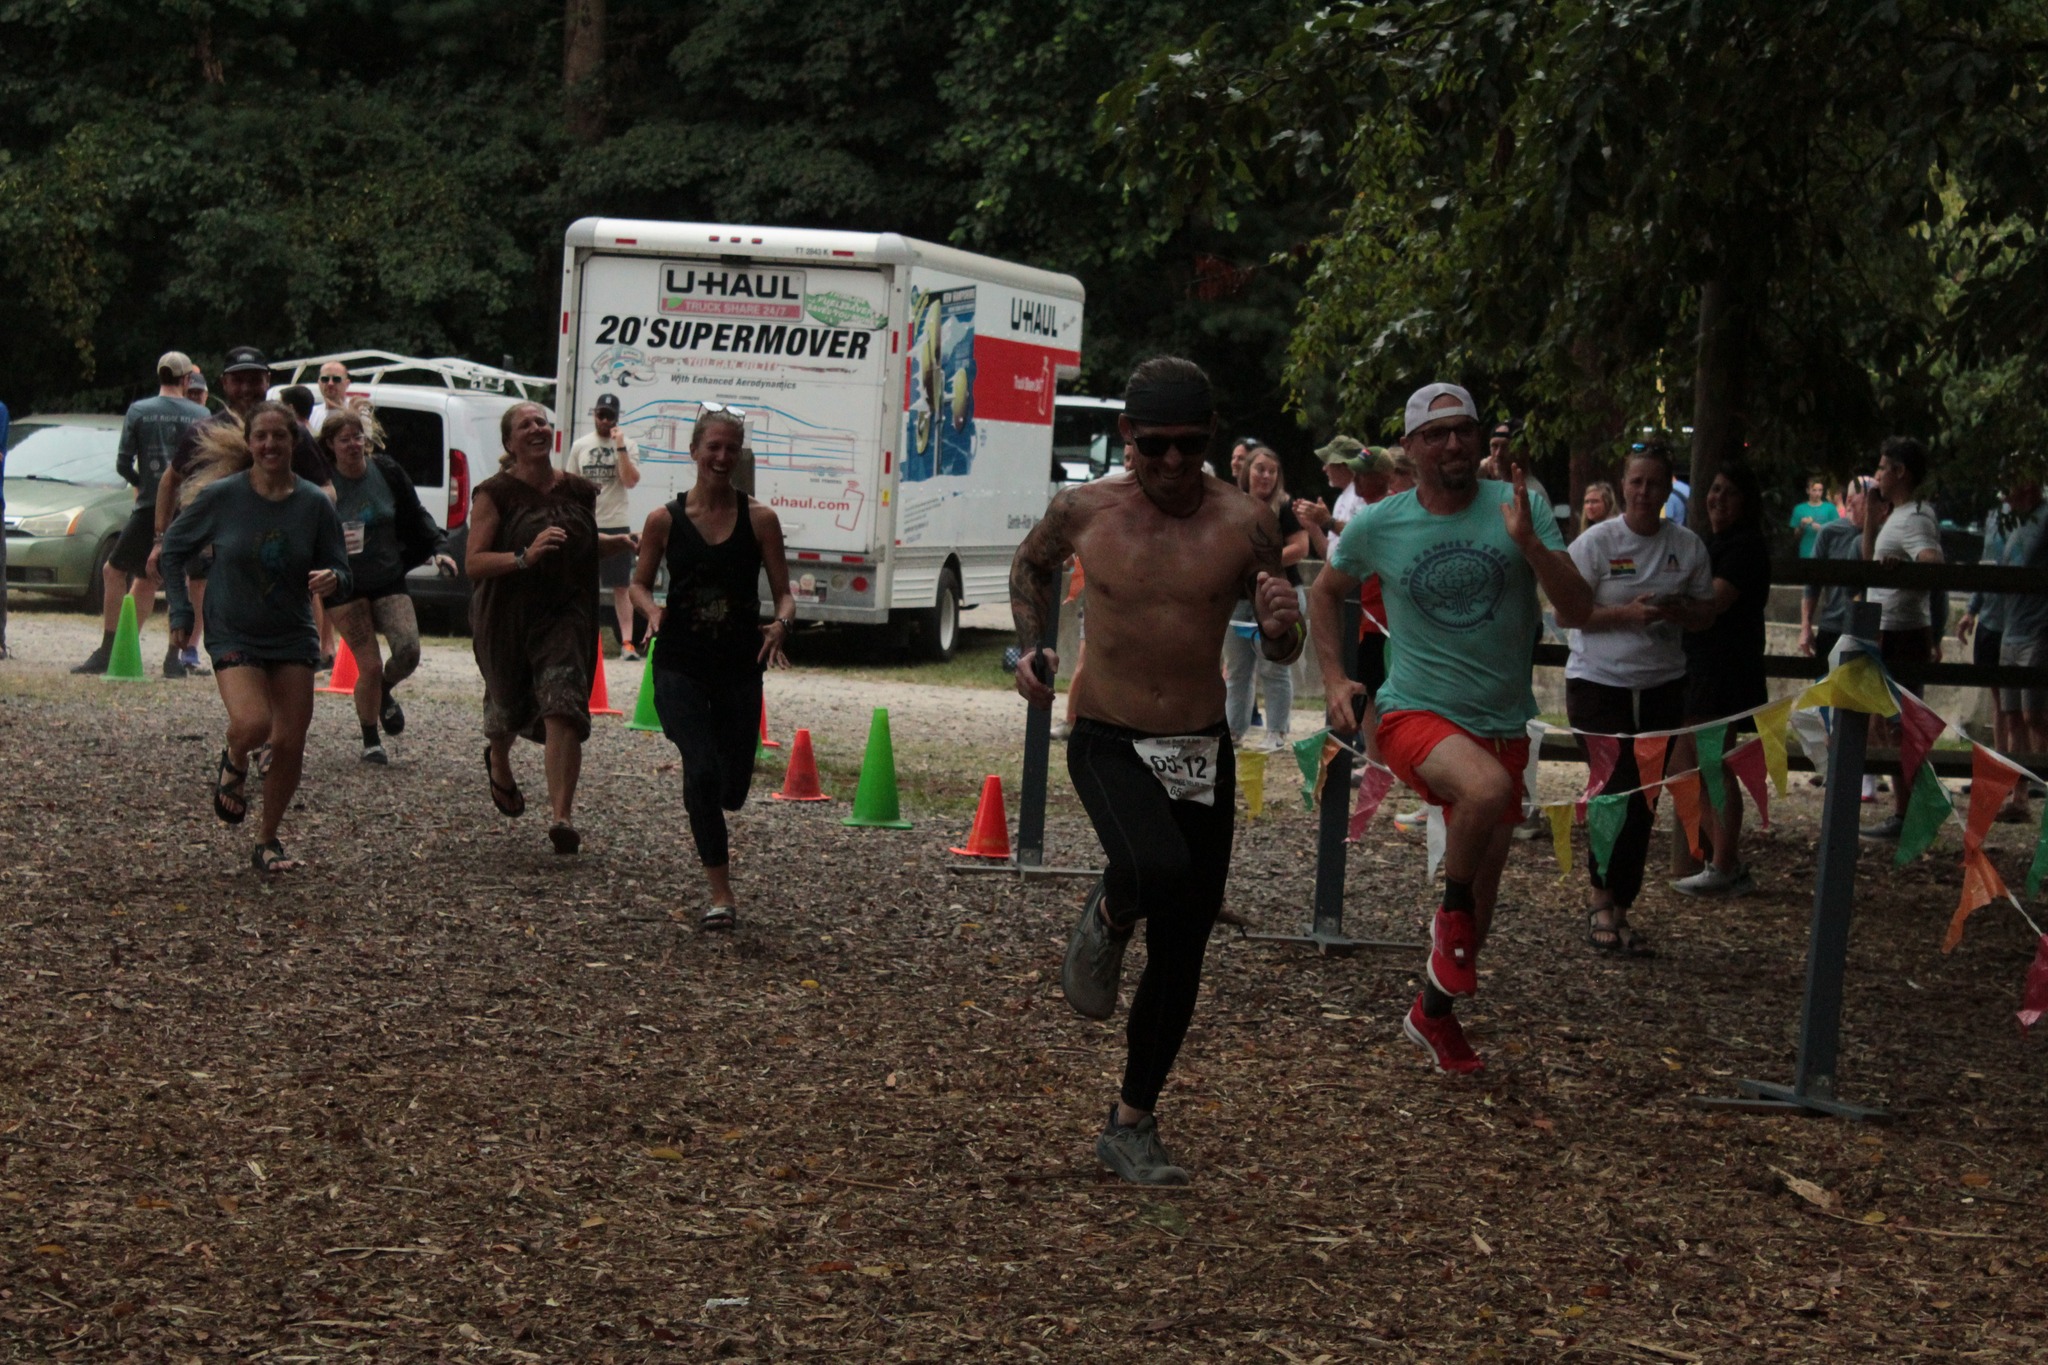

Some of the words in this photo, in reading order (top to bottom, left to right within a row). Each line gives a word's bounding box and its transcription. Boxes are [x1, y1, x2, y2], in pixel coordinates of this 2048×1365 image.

[685, 301, 721, 312] TRUCK
[723, 303, 760, 315] SHARE
[763, 306, 787, 316] 24/7
[1011, 297, 1057, 337] U-HAUL
[671, 374, 689, 385] With
[692, 376, 733, 387] Enhanced
[736, 378, 797, 389] Aerodynamics
[771, 496, 850, 511] uhaul.com
[1170, 785, 1183, 798] 65
